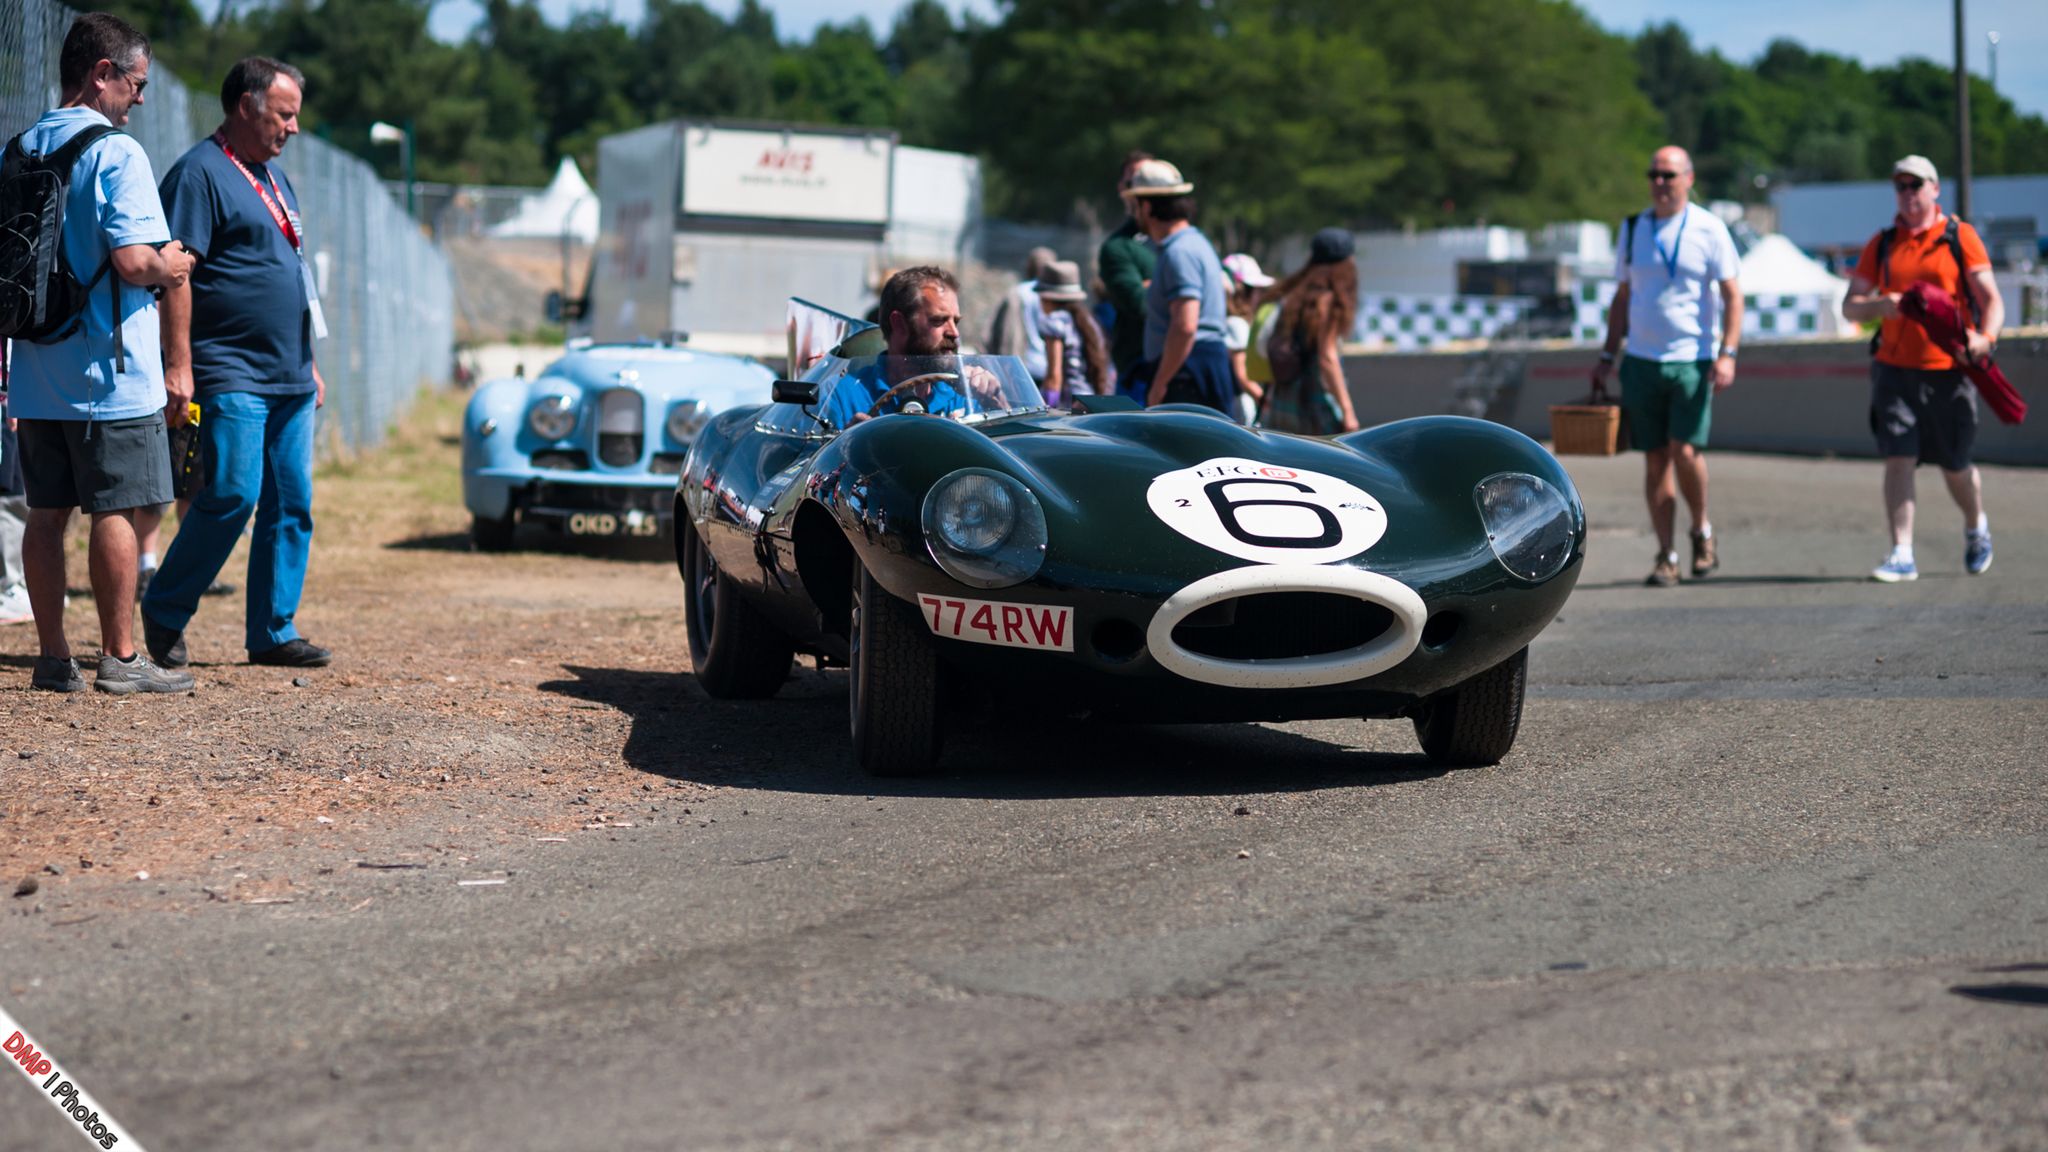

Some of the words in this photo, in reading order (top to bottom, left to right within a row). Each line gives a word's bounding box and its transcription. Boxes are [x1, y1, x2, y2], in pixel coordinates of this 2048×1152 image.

[757, 149, 814, 173] AVIS
[1196, 466, 1257, 478] EFG
[1174, 499, 1192, 508] 2
[1203, 478, 1343, 549] 6
[569, 513, 617, 536] OKD
[922, 597, 1067, 647] 774RW
